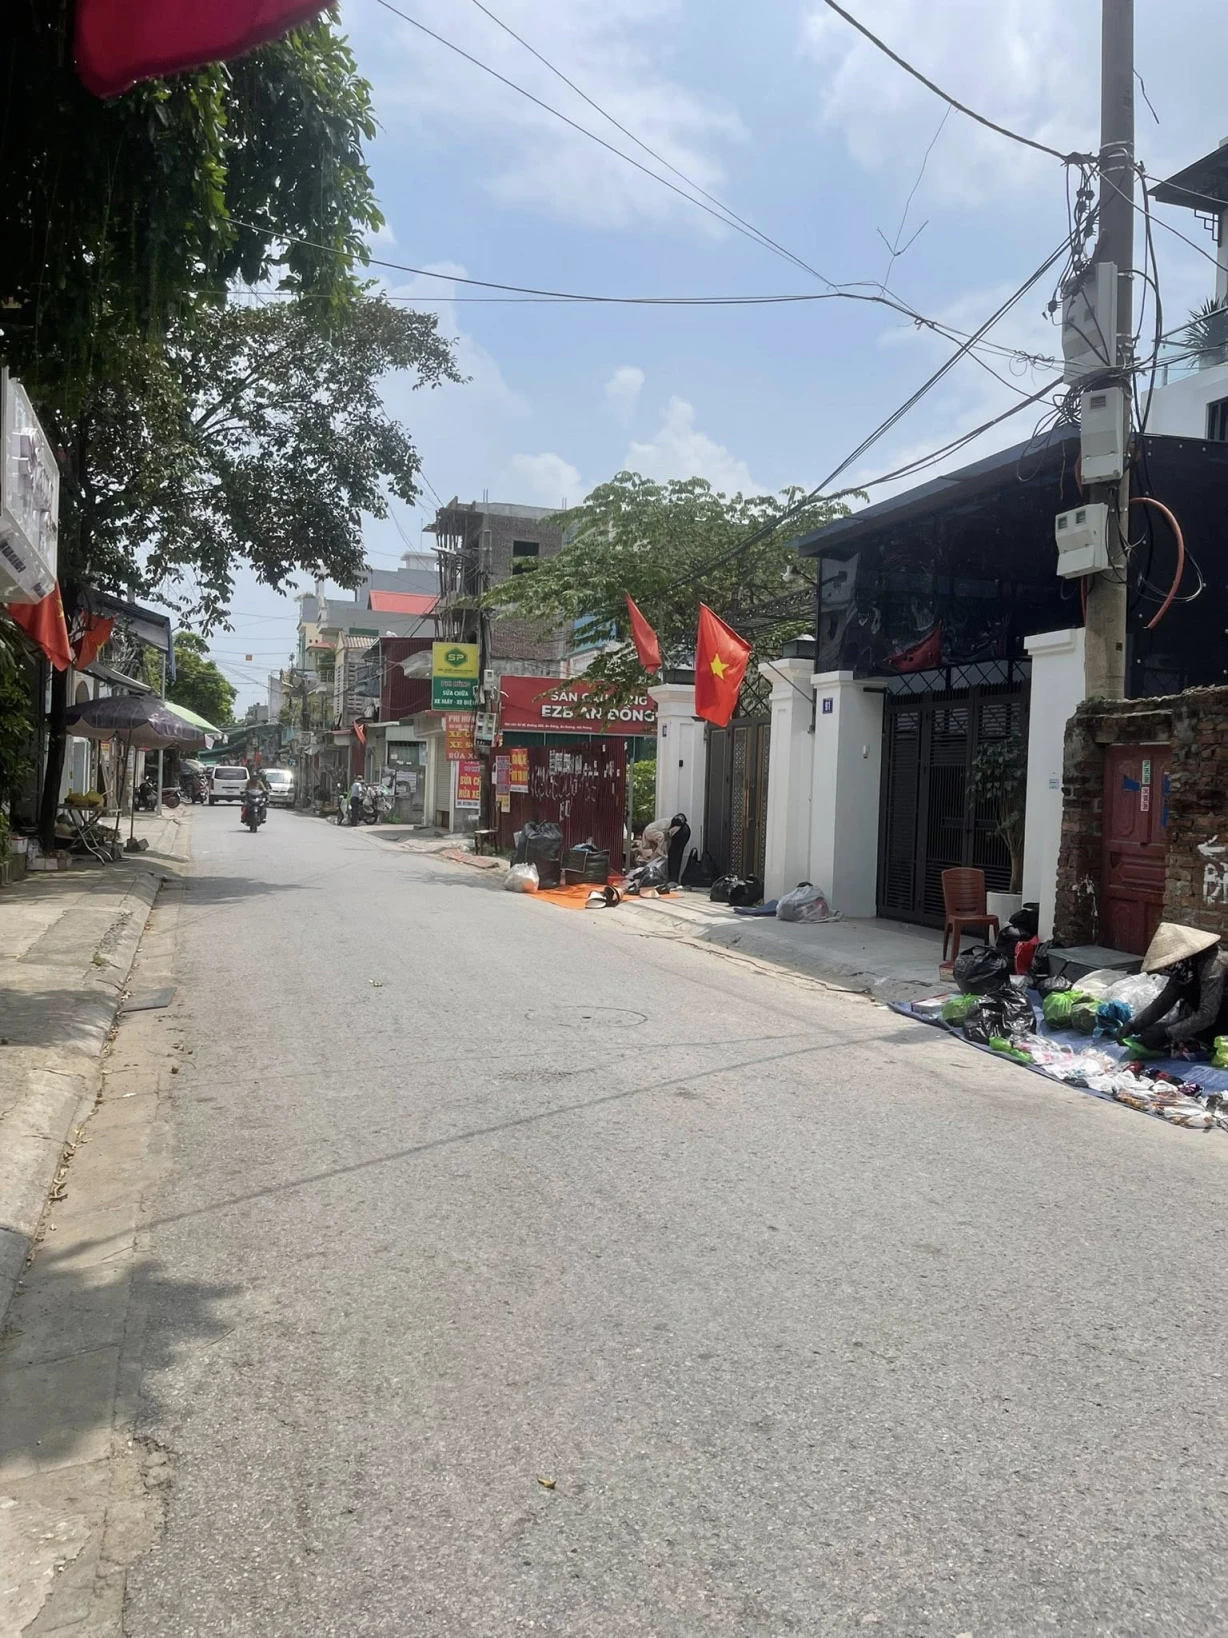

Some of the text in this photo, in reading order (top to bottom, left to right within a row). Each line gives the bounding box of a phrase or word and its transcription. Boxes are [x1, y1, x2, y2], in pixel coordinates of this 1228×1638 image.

[448, 653, 465, 662] SP
[448, 715, 460, 723] PHI
[449, 741, 463, 749] XE
